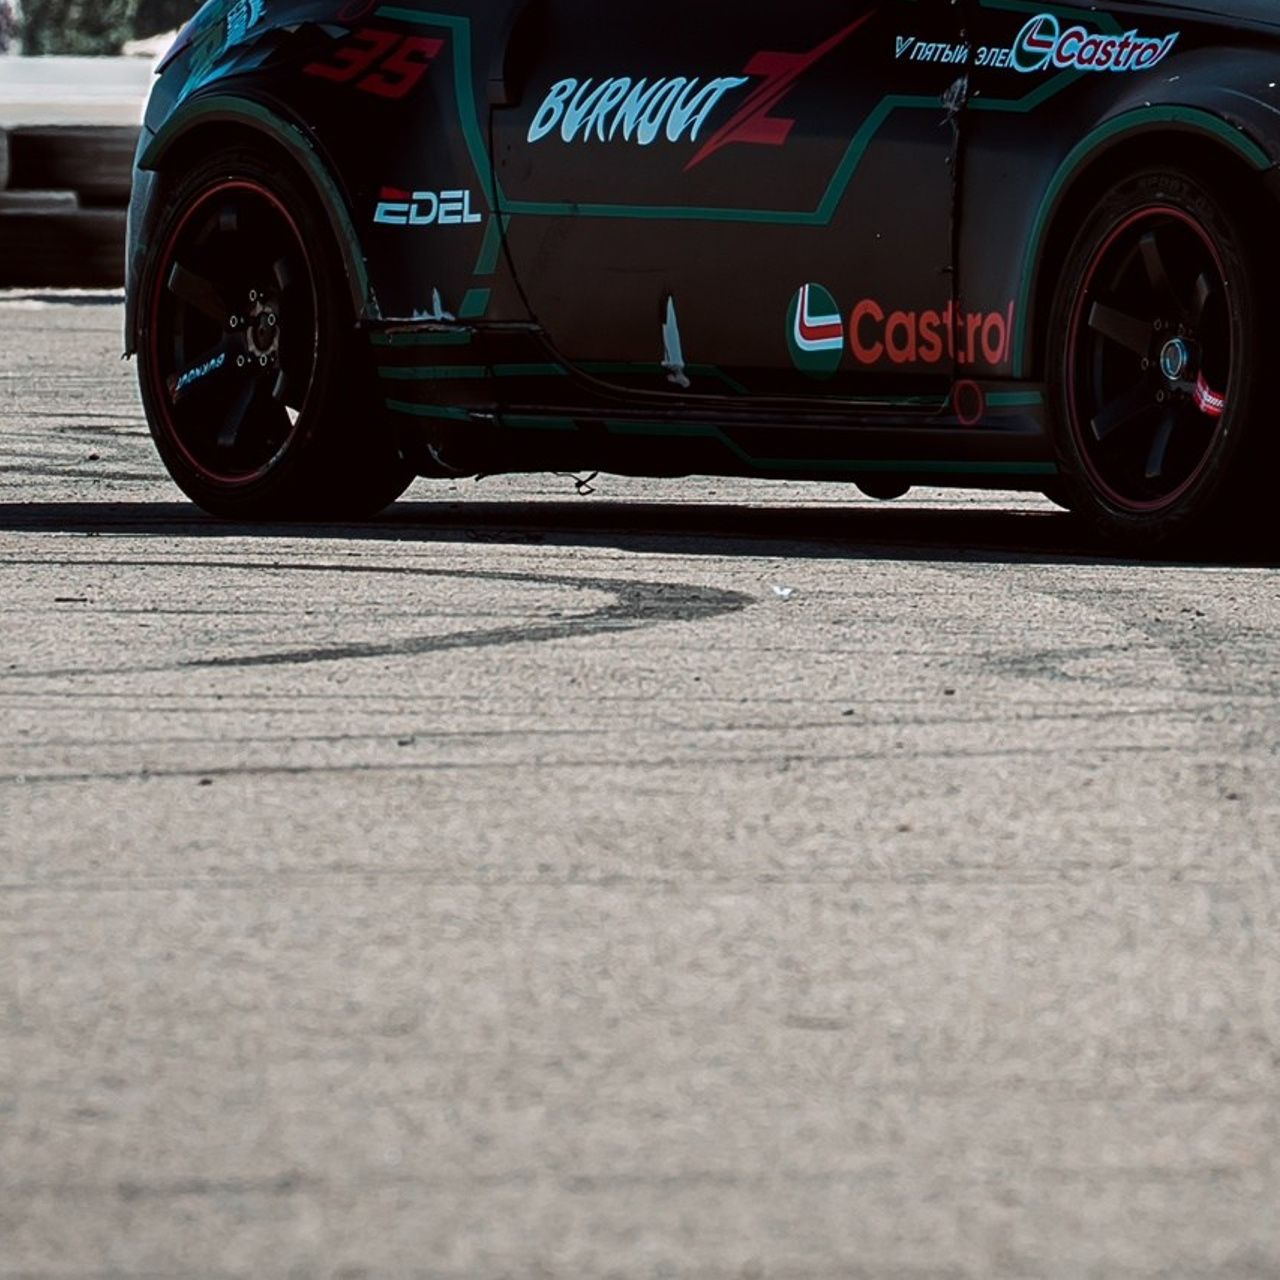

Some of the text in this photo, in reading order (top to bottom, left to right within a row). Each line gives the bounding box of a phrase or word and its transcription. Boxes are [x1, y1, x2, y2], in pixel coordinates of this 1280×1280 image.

[302, 28, 445, 99] 35
[909, 40, 971, 64] ПЯТЫЙ
[1052, 25, 1180, 71] Castrol
[526, 77, 749, 146] BURNOUT
[373, 186, 482, 225] EDEL
[851, 299, 1015, 364] Castrol
